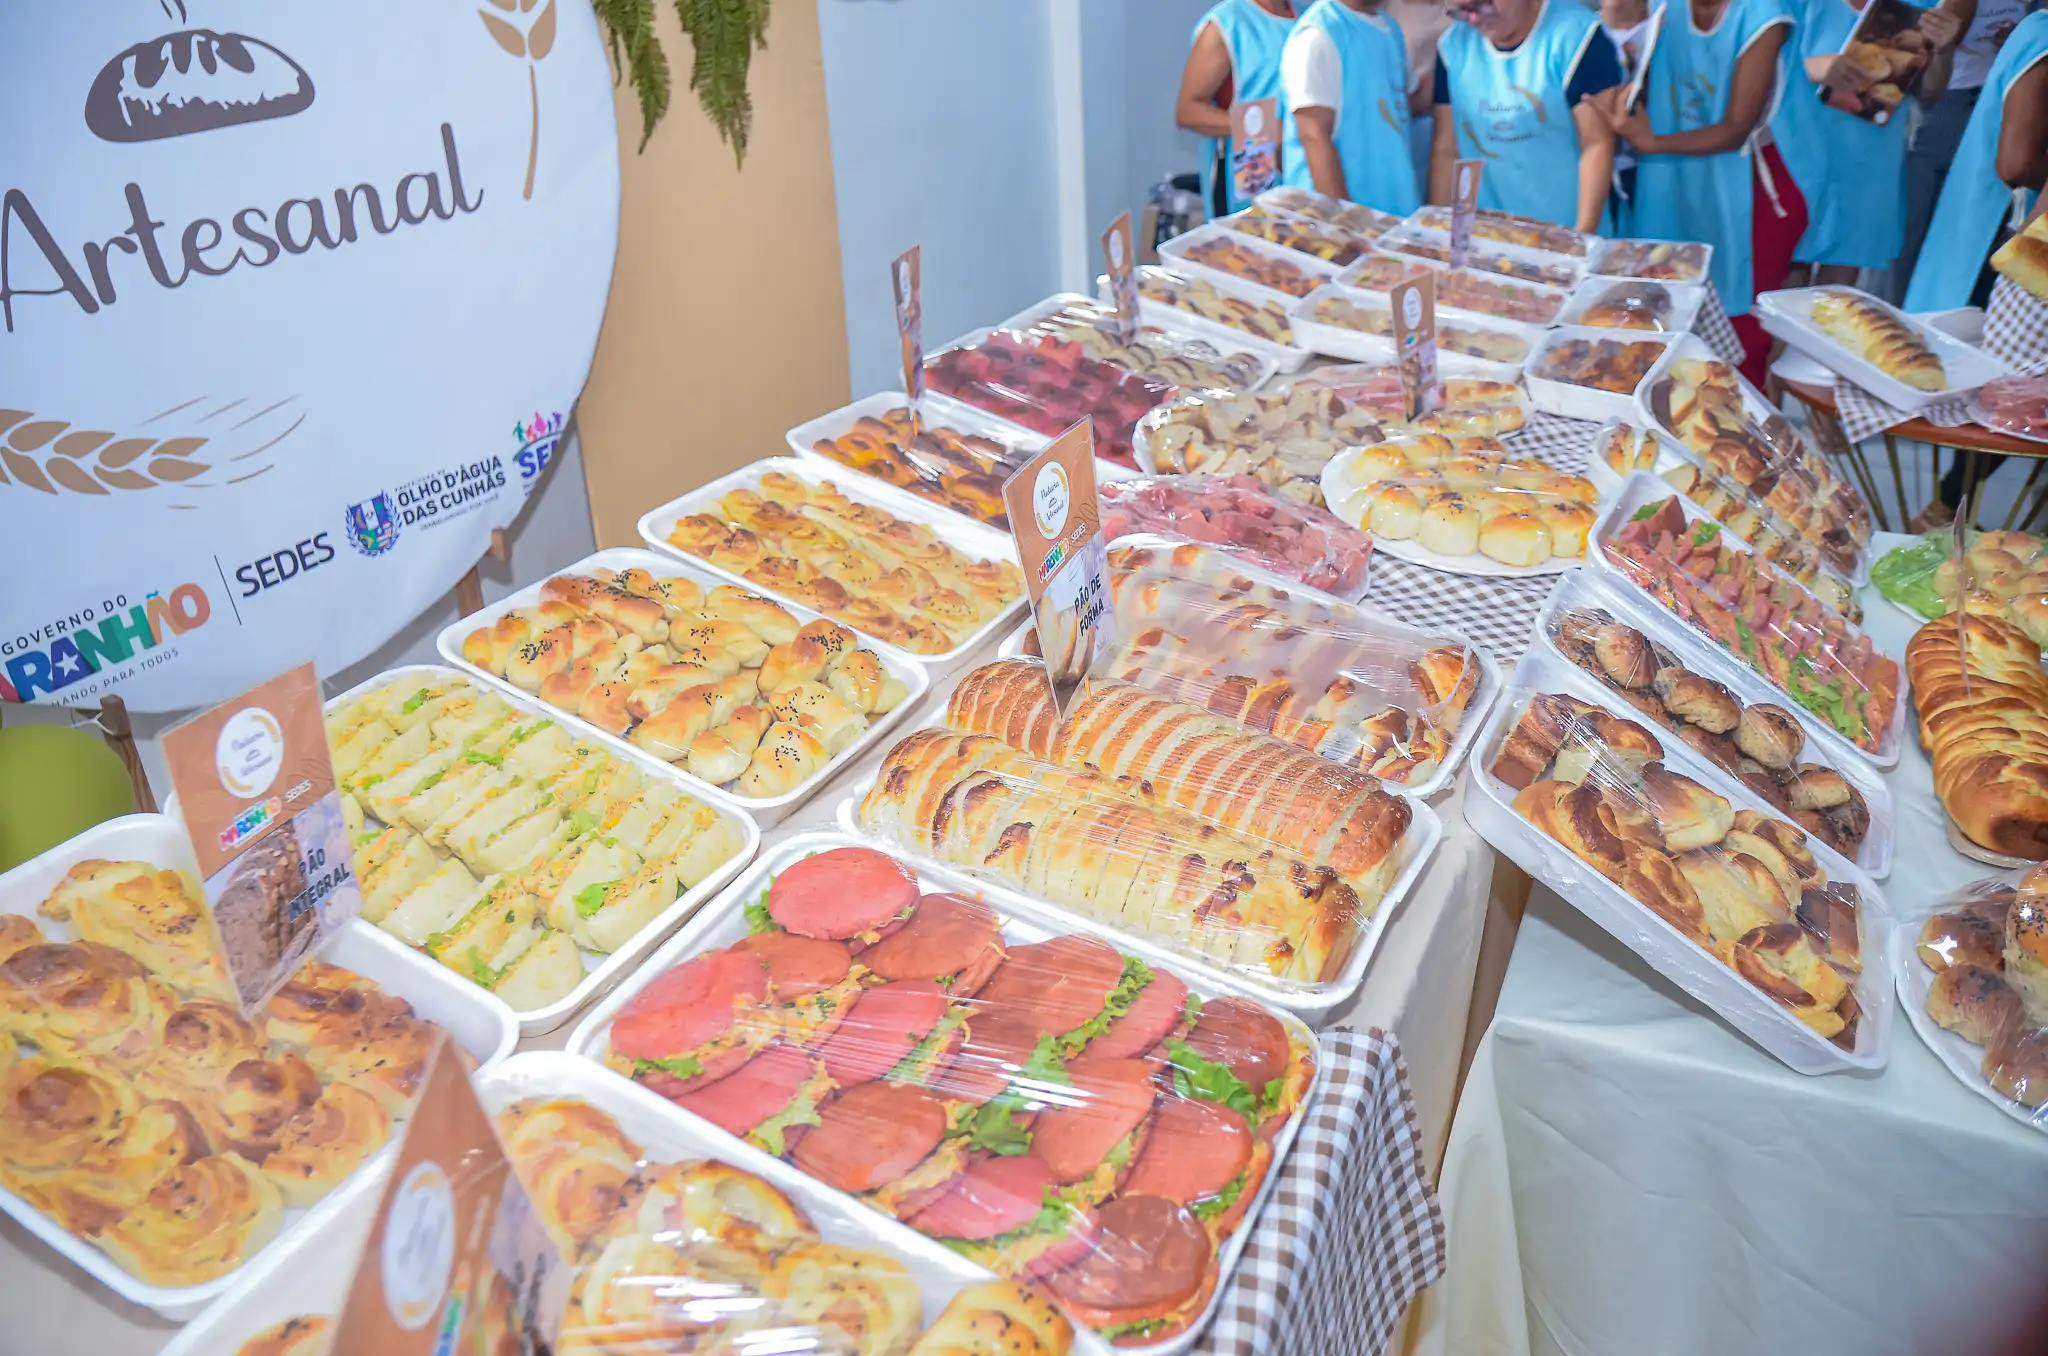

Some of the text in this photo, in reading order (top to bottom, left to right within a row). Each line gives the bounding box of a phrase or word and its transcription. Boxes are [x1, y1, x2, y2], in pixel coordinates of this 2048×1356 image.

[0, 122, 484, 333] Artesanal
[398, 479, 442, 507] OLHO
[403, 500, 438, 526] DAS
[236, 532, 335, 598] SEDES
[1074, 573, 1102, 615] PÃO DE
[1, 594, 127, 656] GOVERNO DO
[1079, 597, 1105, 637] FORMA
[103, 667, 136, 688] PARA
[141, 647, 180, 671] TODOS
[298, 848, 326, 879] PÃO
